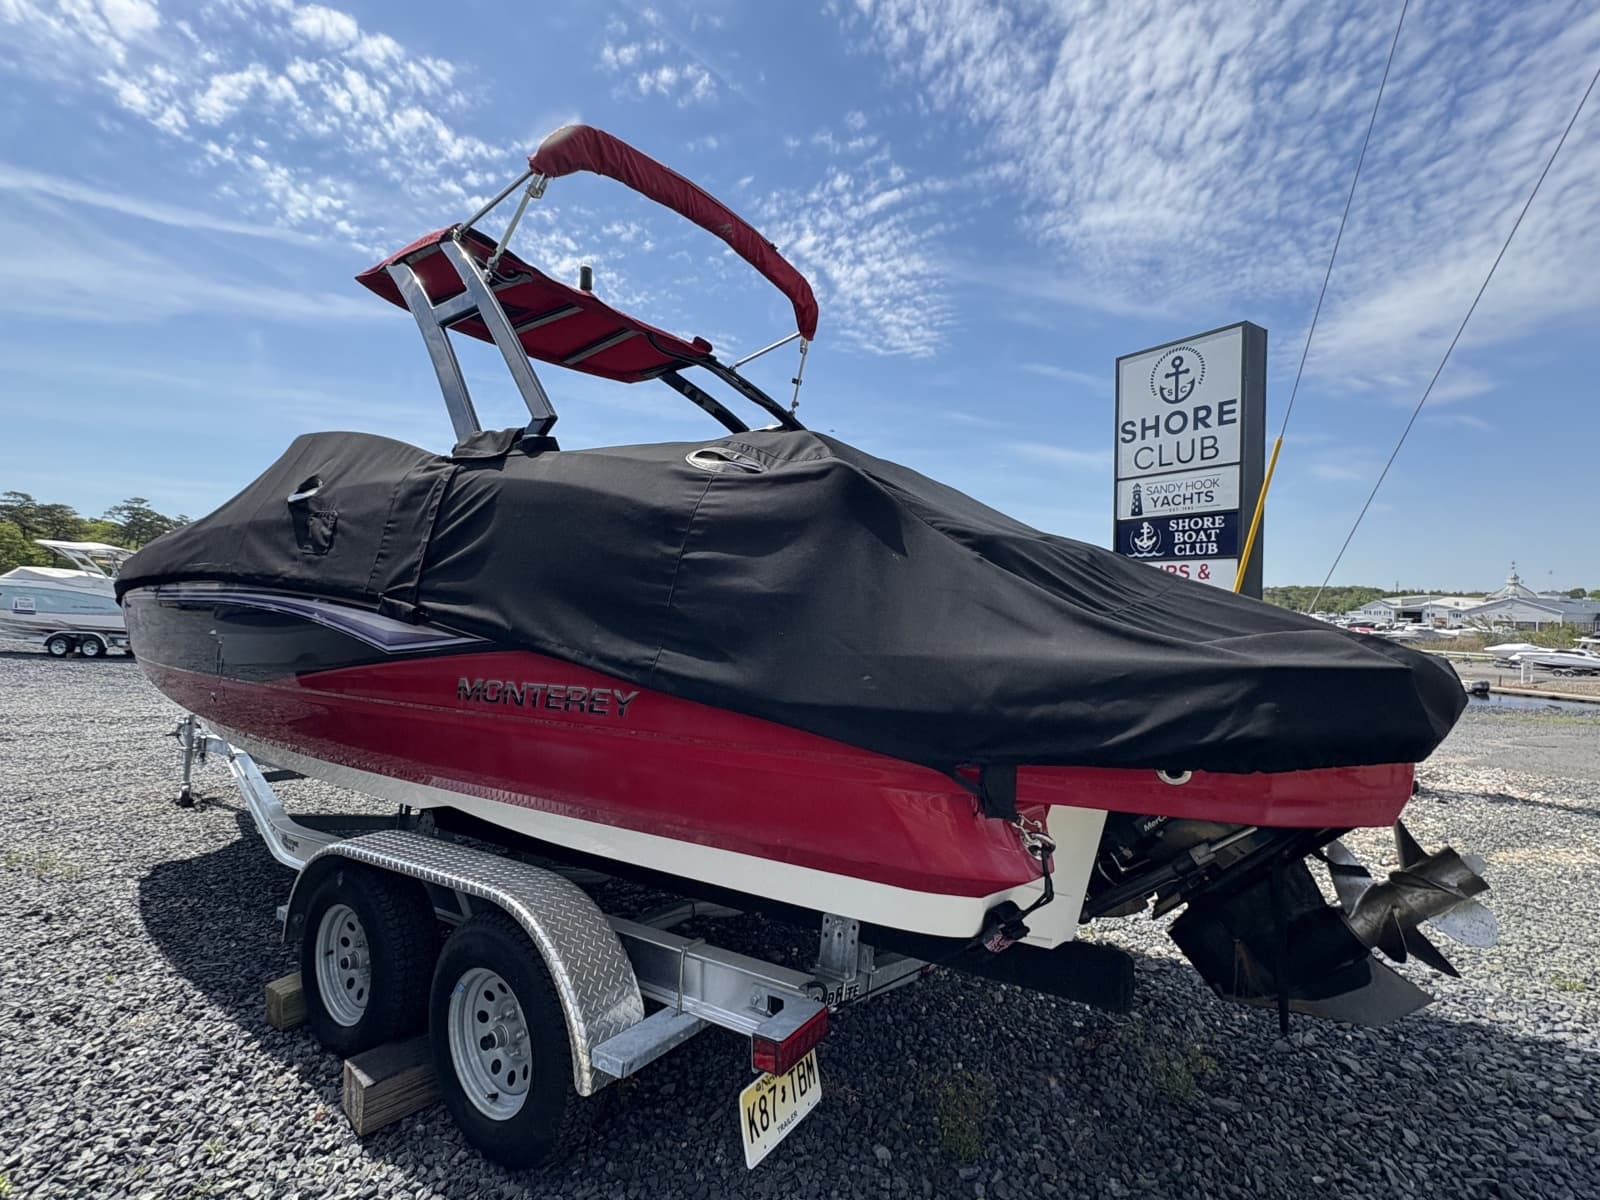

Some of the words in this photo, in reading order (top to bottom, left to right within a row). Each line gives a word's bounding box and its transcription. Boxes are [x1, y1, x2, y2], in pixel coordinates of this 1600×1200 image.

[1120, 398, 1237, 444] SHORE
[1134, 435, 1220, 470] CLUB
[1146, 481, 1183, 496] SANDY
[1185, 478, 1220, 492] HOOK
[1151, 490, 1214, 508] YACHTS
[1169, 515, 1225, 531] SHORE
[1173, 529, 1220, 544] BOAT
[1174, 543, 1218, 555] CLUB
[1198, 563, 1210, 579] &
[457, 676, 640, 718] MONTEREY
[747, 1084, 777, 1144] K87
[788, 1053, 816, 1103] TBM
[776, 1110, 799, 1135] TRAILER
